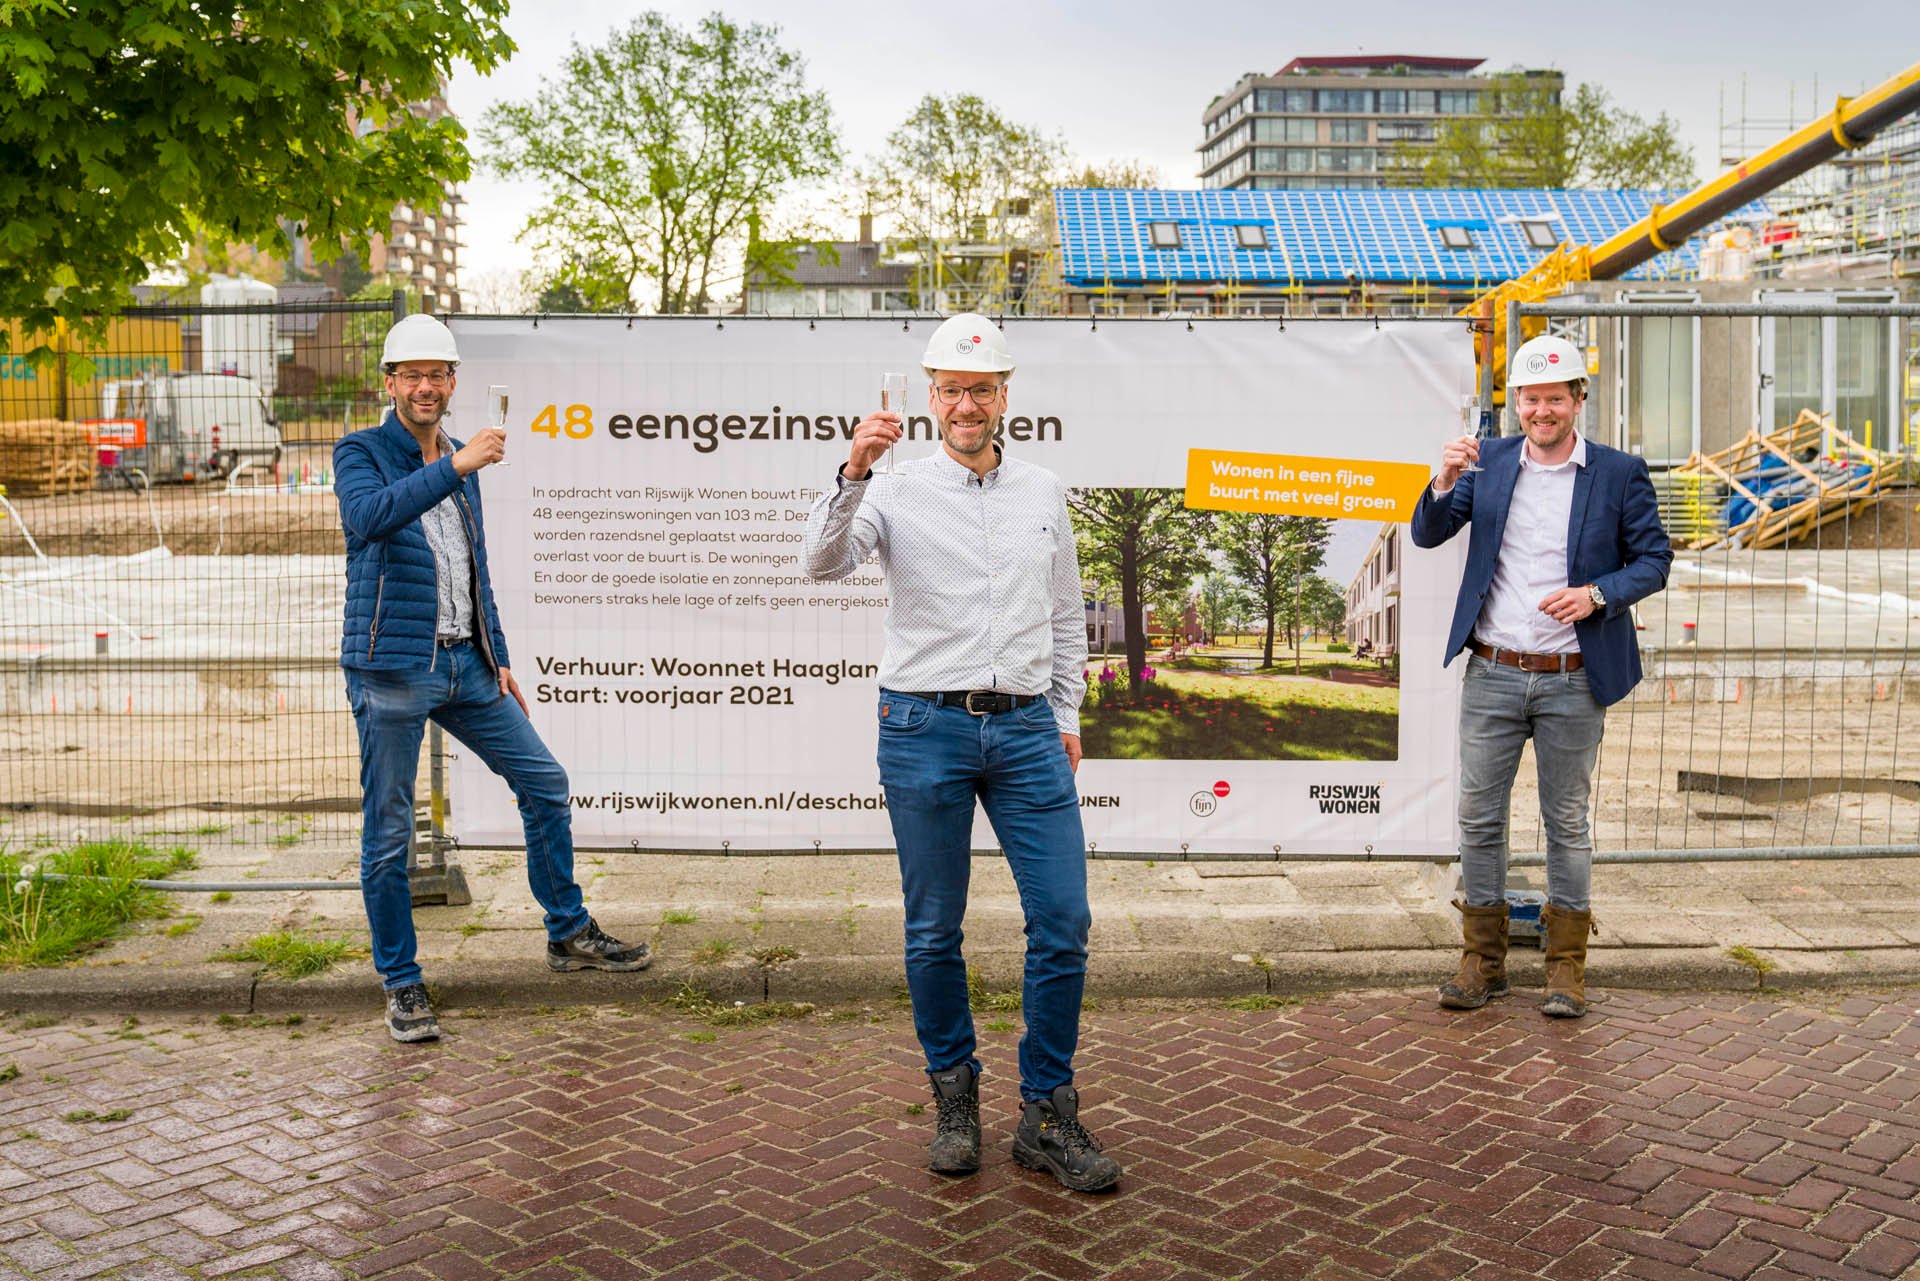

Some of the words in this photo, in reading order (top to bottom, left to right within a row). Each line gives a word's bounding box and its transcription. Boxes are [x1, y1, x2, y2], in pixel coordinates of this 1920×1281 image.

[530, 403, 594, 440] 48
[608, 406, 1063, 454] eengezinsnen
[1211, 460, 1274, 480] Wonen
[1279, 465, 1294, 481] in
[1299, 470, 1331, 484] een
[1336, 469, 1375, 489] fijne
[532, 486, 545, 498] In
[548, 487, 612, 502] opdracht
[615, 489, 641, 499] van
[645, 486, 695, 502] Rijswijk
[697, 487, 748, 500] Wonen
[751, 487, 796, 501] bouwt
[1209, 483, 1260, 501] buurt
[1264, 488, 1299, 503] met
[1303, 491, 1339, 506] veel
[1343, 495, 1396, 513] groen
[532, 507, 553, 520] 48
[555, 508, 692, 524] eengezinswoningen
[695, 511, 721, 521] van
[724, 508, 751, 521] 103
[754, 509, 780, 522] m2.
[533, 529, 586, 541] worden
[589, 529, 665, 542] razendsnel
[668, 530, 736, 546] geplaatst
[533, 550, 590, 563] overlast
[592, 553, 624, 563] voor
[627, 551, 645, 563] de
[648, 551, 687, 563] buurt
[690, 551, 704, 564] is.
[708, 551, 728, 564] De
[730, 552, 799, 567] woningen
[534, 570, 552, 583] En
[556, 572, 588, 583] door
[592, 571, 609, 584] de
[612, 572, 656, 588] goede
[659, 572, 709, 585] isolatie
[712, 575, 730, 585] en
[534, 591, 603, 605] bewoners
[606, 593, 649, 605] straks
[652, 593, 681, 606] hele
[684, 593, 715, 610] lage
[717, 593, 733, 606] of
[735, 594, 767, 607] zelfs
[769, 597, 805, 610] geen
[535, 656, 645, 677] Verhuur:
[651, 657, 766, 678] Woonnet
[536, 683, 608, 704] Start:
[614, 684, 724, 710] voorjaar
[729, 685, 795, 706] 2021
[1194, 797, 1212, 813] fijn
